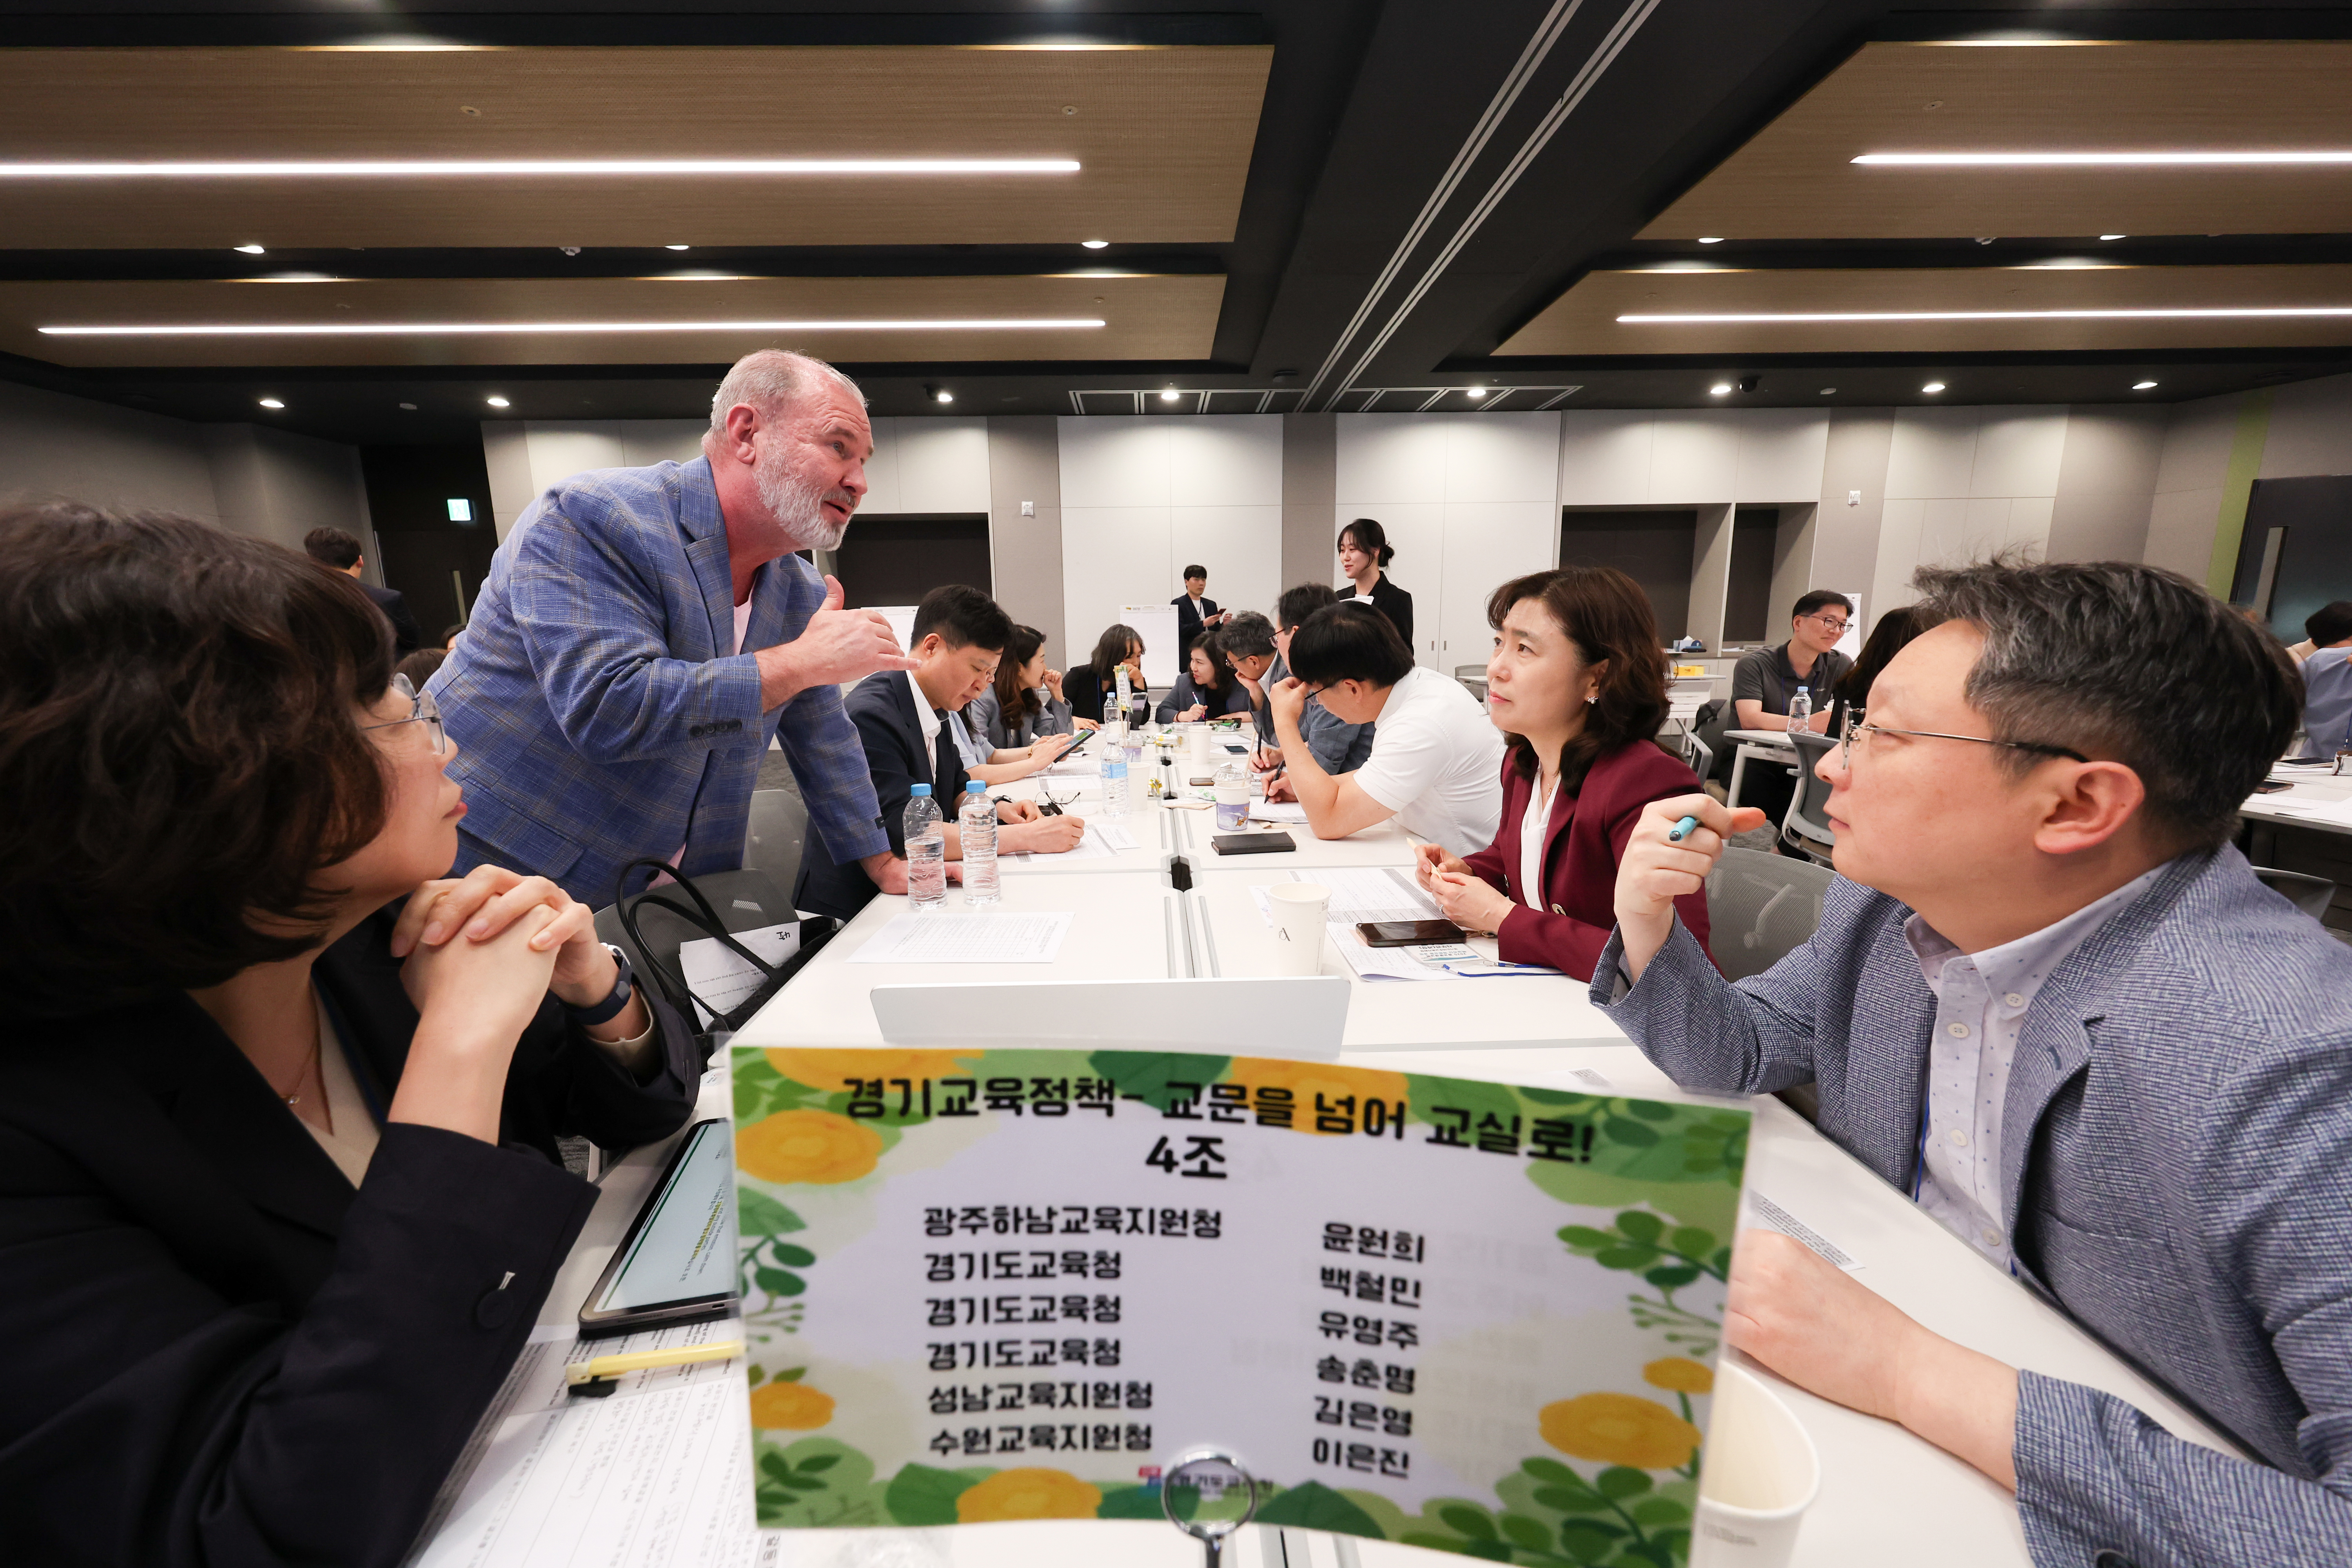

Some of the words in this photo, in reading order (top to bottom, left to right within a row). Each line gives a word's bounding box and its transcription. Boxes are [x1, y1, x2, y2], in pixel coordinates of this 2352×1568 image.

[843, 1077, 1146, 1120] 경기교육정책-
[1162, 1081, 1296, 1128] 교문을
[1315, 1093, 1406, 1140] 넘어
[1425, 1105, 1596, 1164] 교실로!
[1145, 1136, 1227, 1180] 4조
[924, 1205, 1221, 1239] 광주하남교육지원청
[1323, 1222, 1425, 1263] 윤원희
[925, 1250, 1122, 1283] 경기도교육청
[1320, 1266, 1421, 1309] 백철민
[926, 1294, 1121, 1327] 경기도교육청
[1319, 1311, 1419, 1350] 유영주
[927, 1338, 1121, 1371] 경기도교육청
[1317, 1355, 1416, 1395] 송춘명
[928, 1381, 1153, 1414] 성남교육지원청
[1315, 1396, 1413, 1437] 김은영
[930, 1424, 1152, 1456] 수원교육지원청
[1312, 1438, 1410, 1479] 이은진
